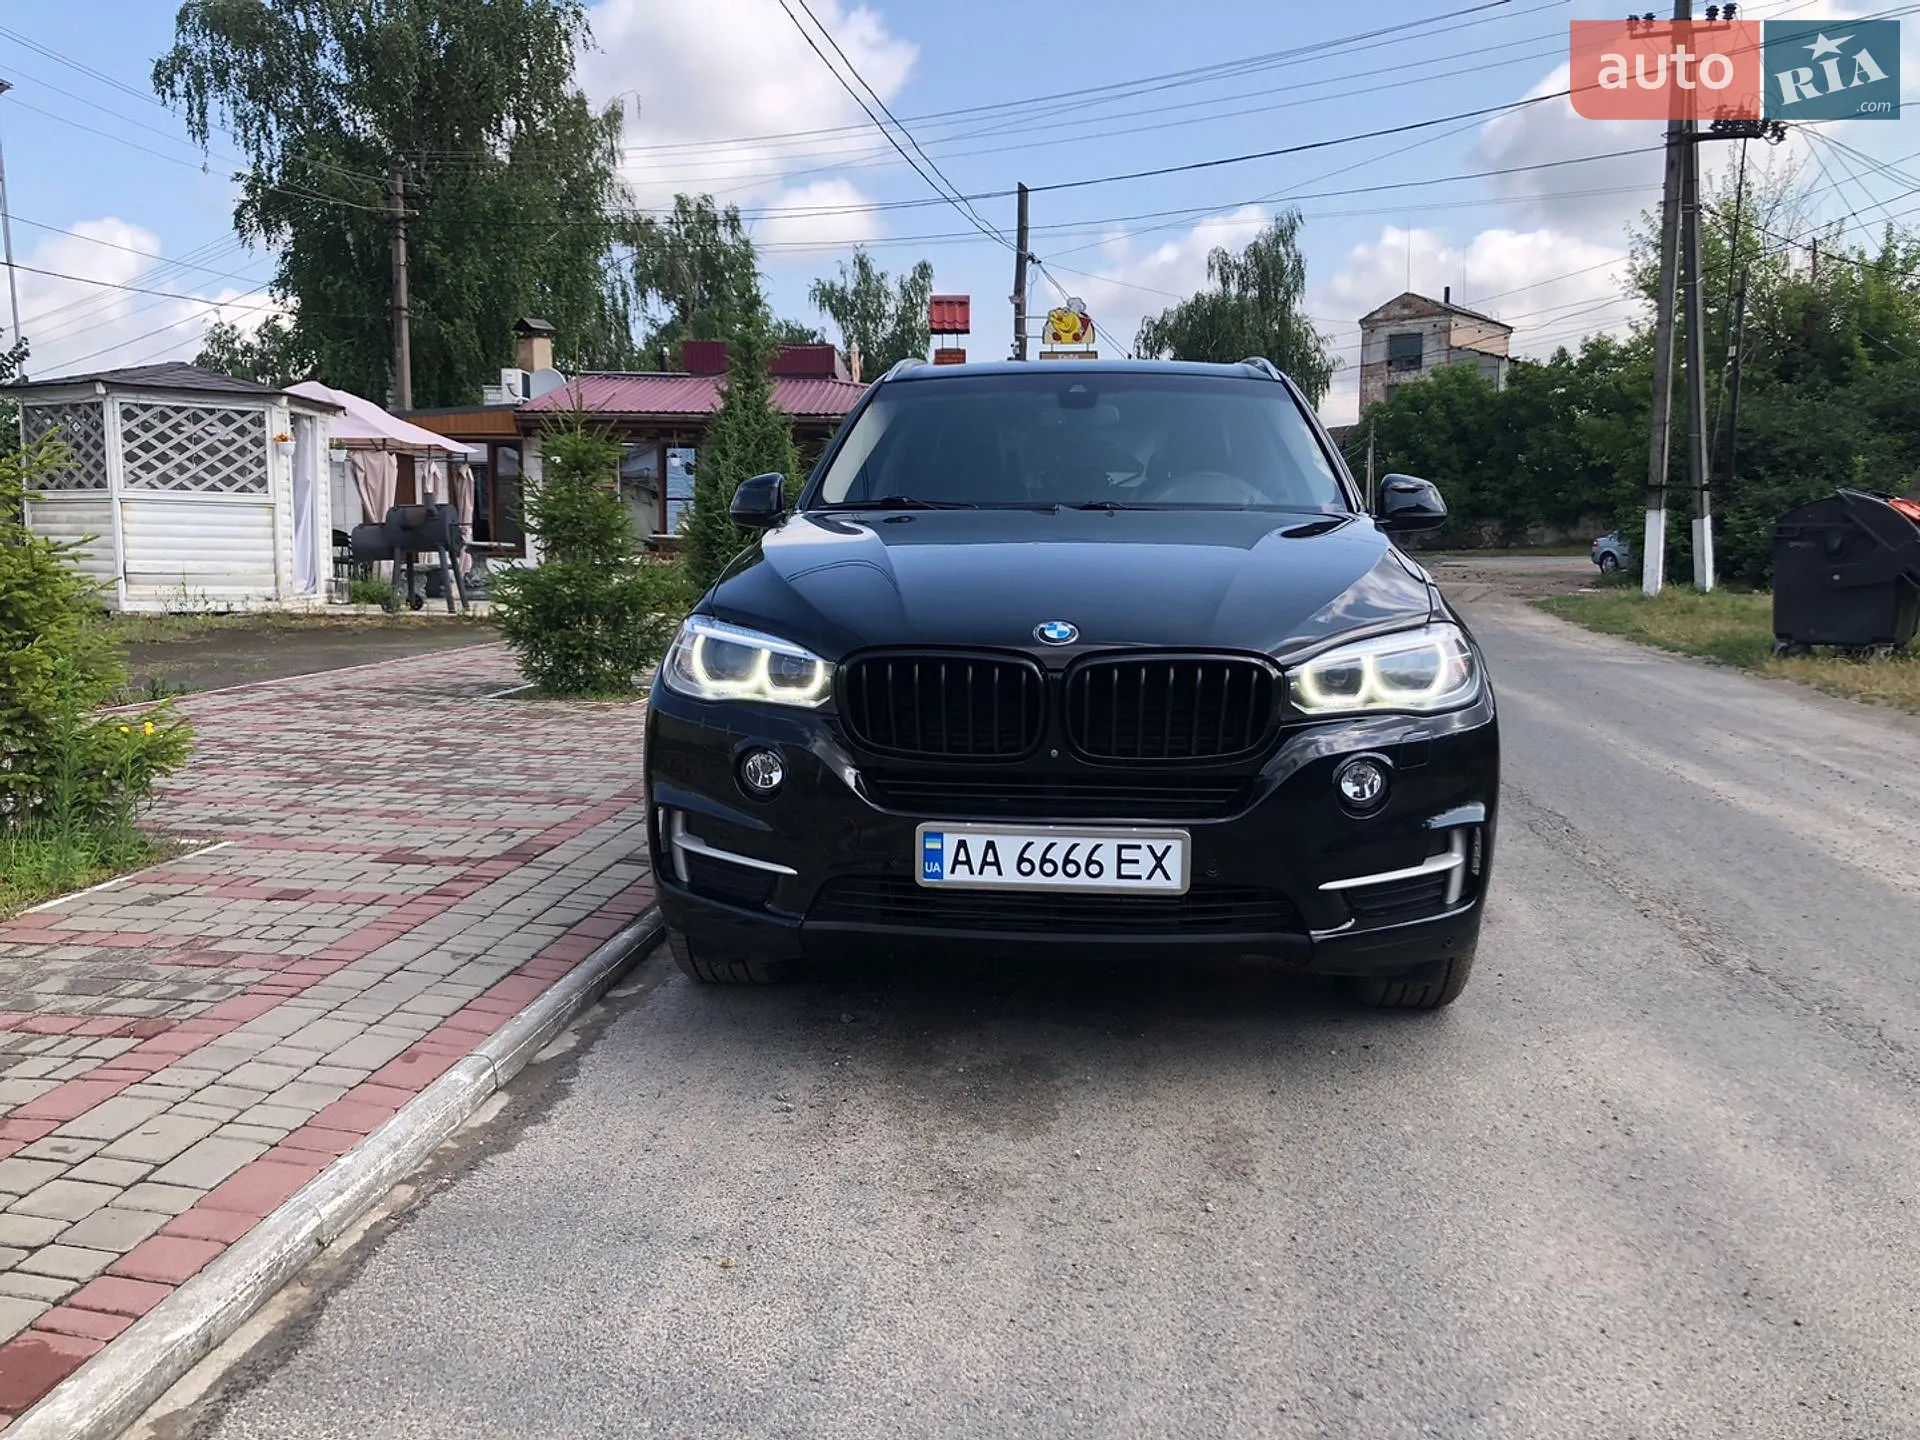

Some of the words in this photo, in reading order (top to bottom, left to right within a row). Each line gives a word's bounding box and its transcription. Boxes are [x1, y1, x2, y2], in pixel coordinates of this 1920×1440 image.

[925, 861, 941, 874] UA
[949, 839, 1003, 876] AA
[1016, 841, 1105, 879] 6666
[1116, 844, 1173, 881] EX
